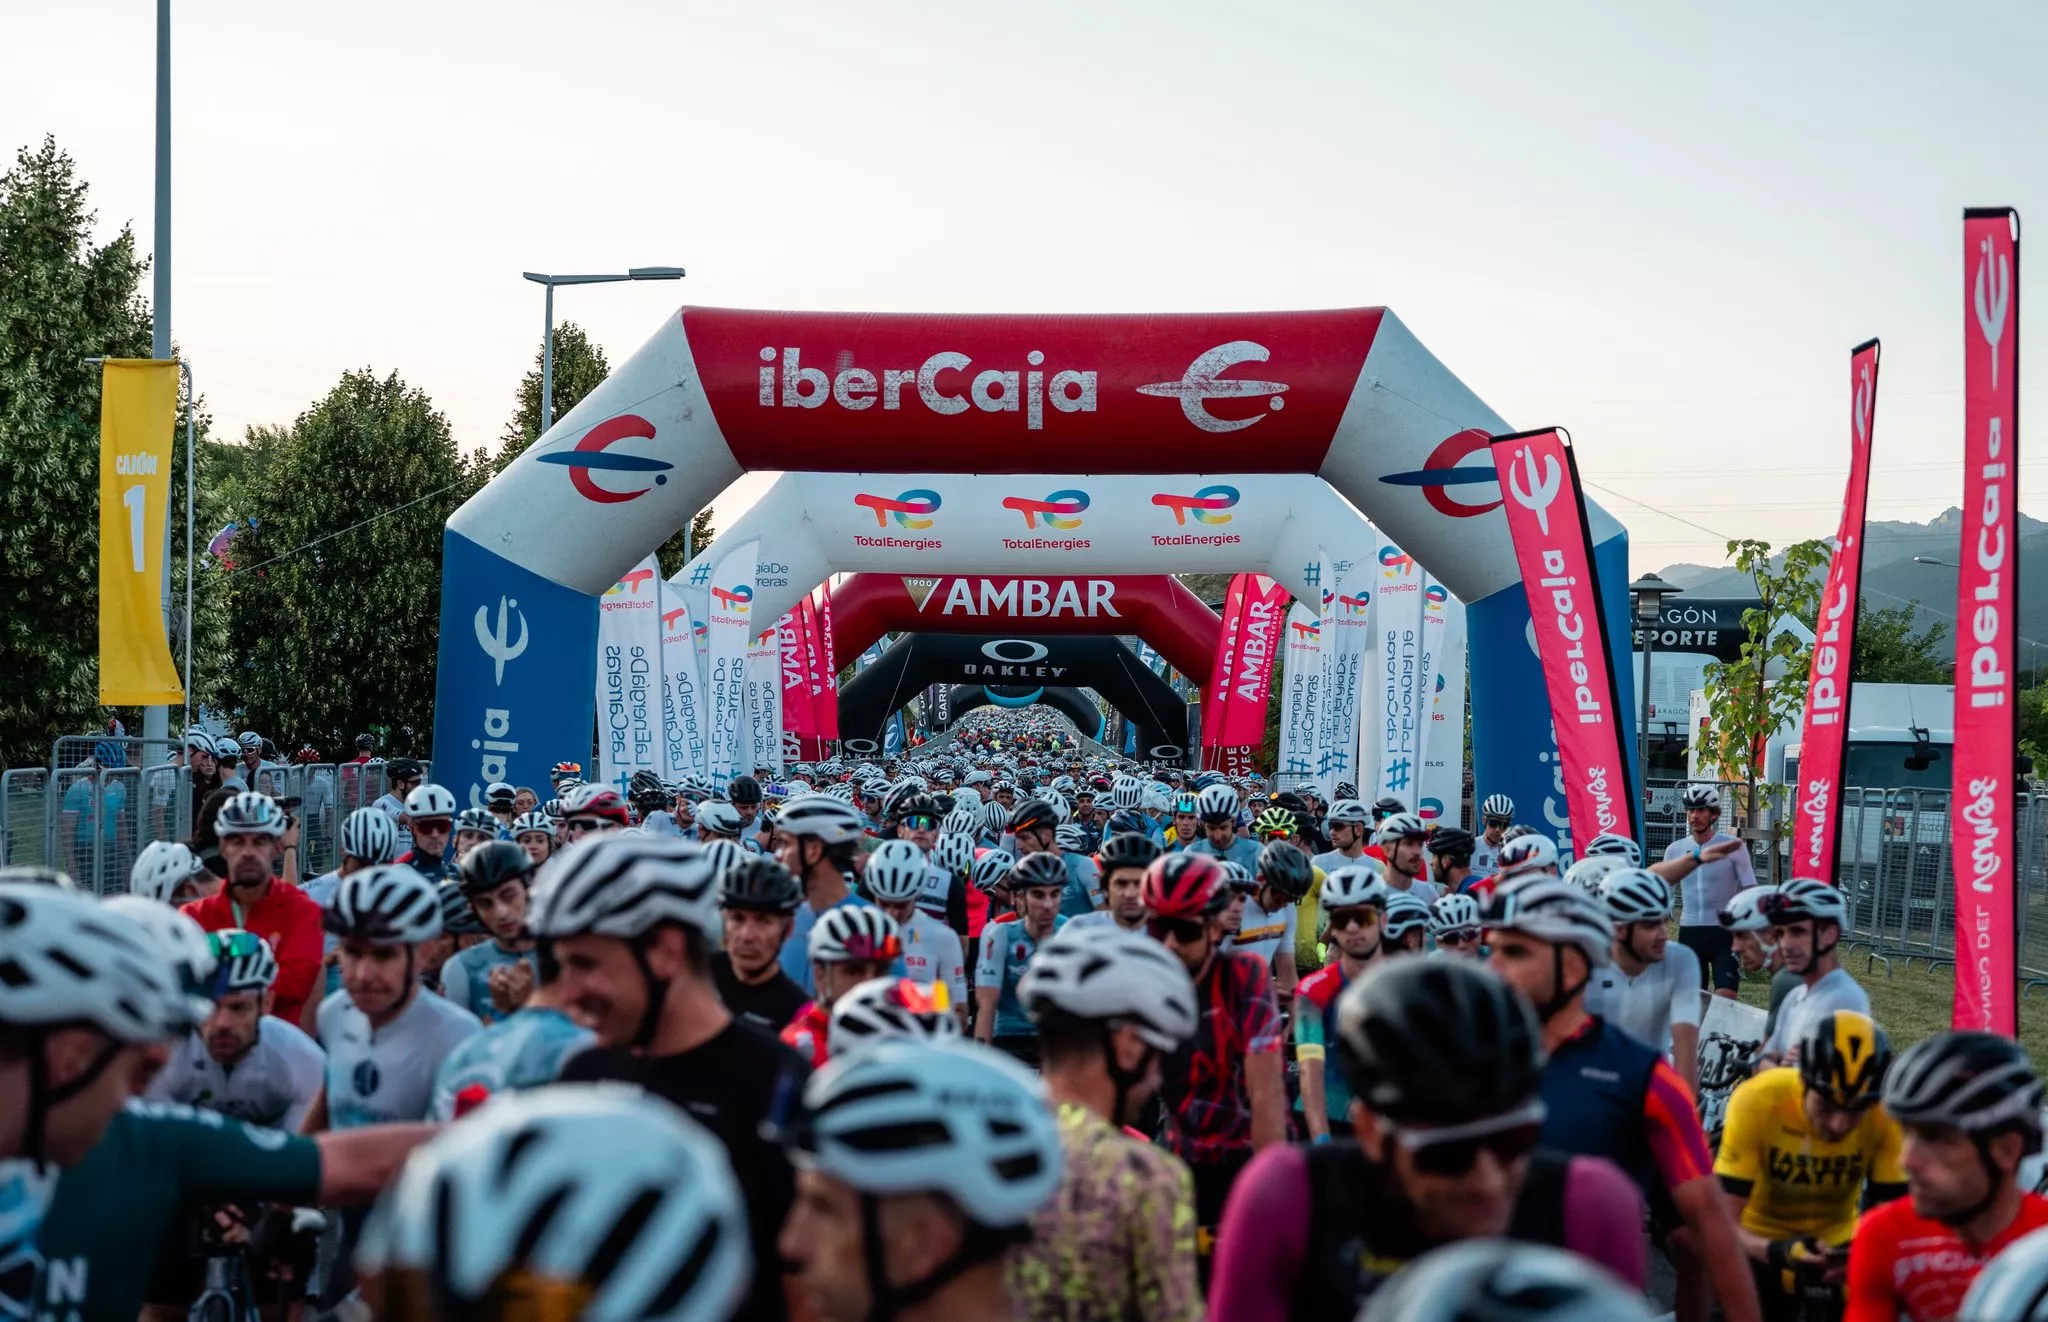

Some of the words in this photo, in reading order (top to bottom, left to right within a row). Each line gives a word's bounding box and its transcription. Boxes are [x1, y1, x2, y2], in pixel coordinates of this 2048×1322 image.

[759, 346, 1097, 430] iberCaja
[116, 452, 158, 475] CAJÓN
[124, 485, 145, 572] 1
[854, 535, 942, 550] TotalEnergies
[1002, 538, 1091, 550] TotalEnergies
[1151, 533, 1241, 546] TotalEnergies
[907, 579, 932, 587] 1900
[942, 578, 1123, 617] AMBAR
[1634, 630, 1718, 646] EPORTE
[1237, 600, 1275, 703] AMBAR
[964, 664, 1064, 677] OAKLEY
[1299, 674, 1320, 755] LasCarreras
